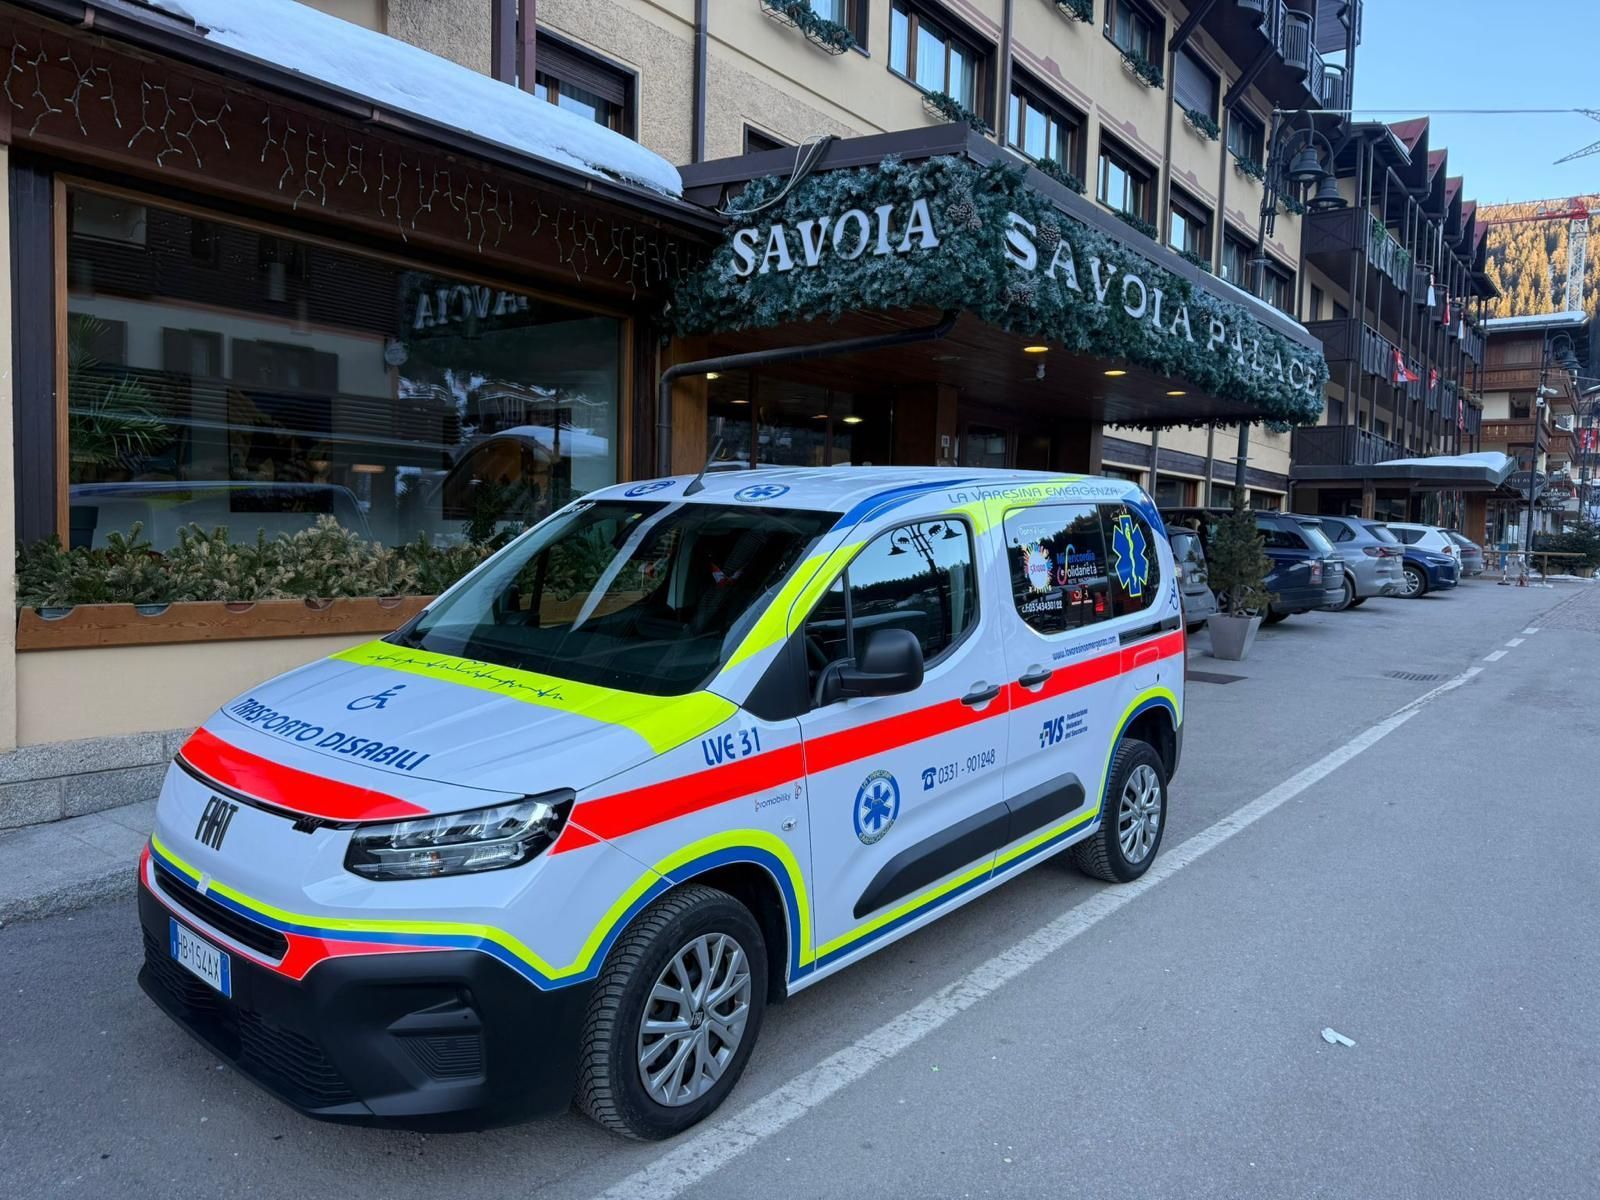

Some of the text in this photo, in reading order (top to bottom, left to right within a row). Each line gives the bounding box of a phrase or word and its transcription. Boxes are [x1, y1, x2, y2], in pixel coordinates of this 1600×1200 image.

[731, 199, 940, 277] SAVOIA
[1004, 211, 1194, 343] SAVOIA
[948, 493, 968, 503] LA
[973, 487, 1042, 502] VARESINA
[1045, 485, 1120, 497] EMERGENZA
[231, 698, 430, 772] TRASPORTO DISABILI
[702, 727, 761, 766] LVE 31
[1040, 715, 1065, 749] FVS
[938, 762, 958, 784] 0331
[966, 748, 996, 774] 901248
[194, 795, 239, 851] FIAT
